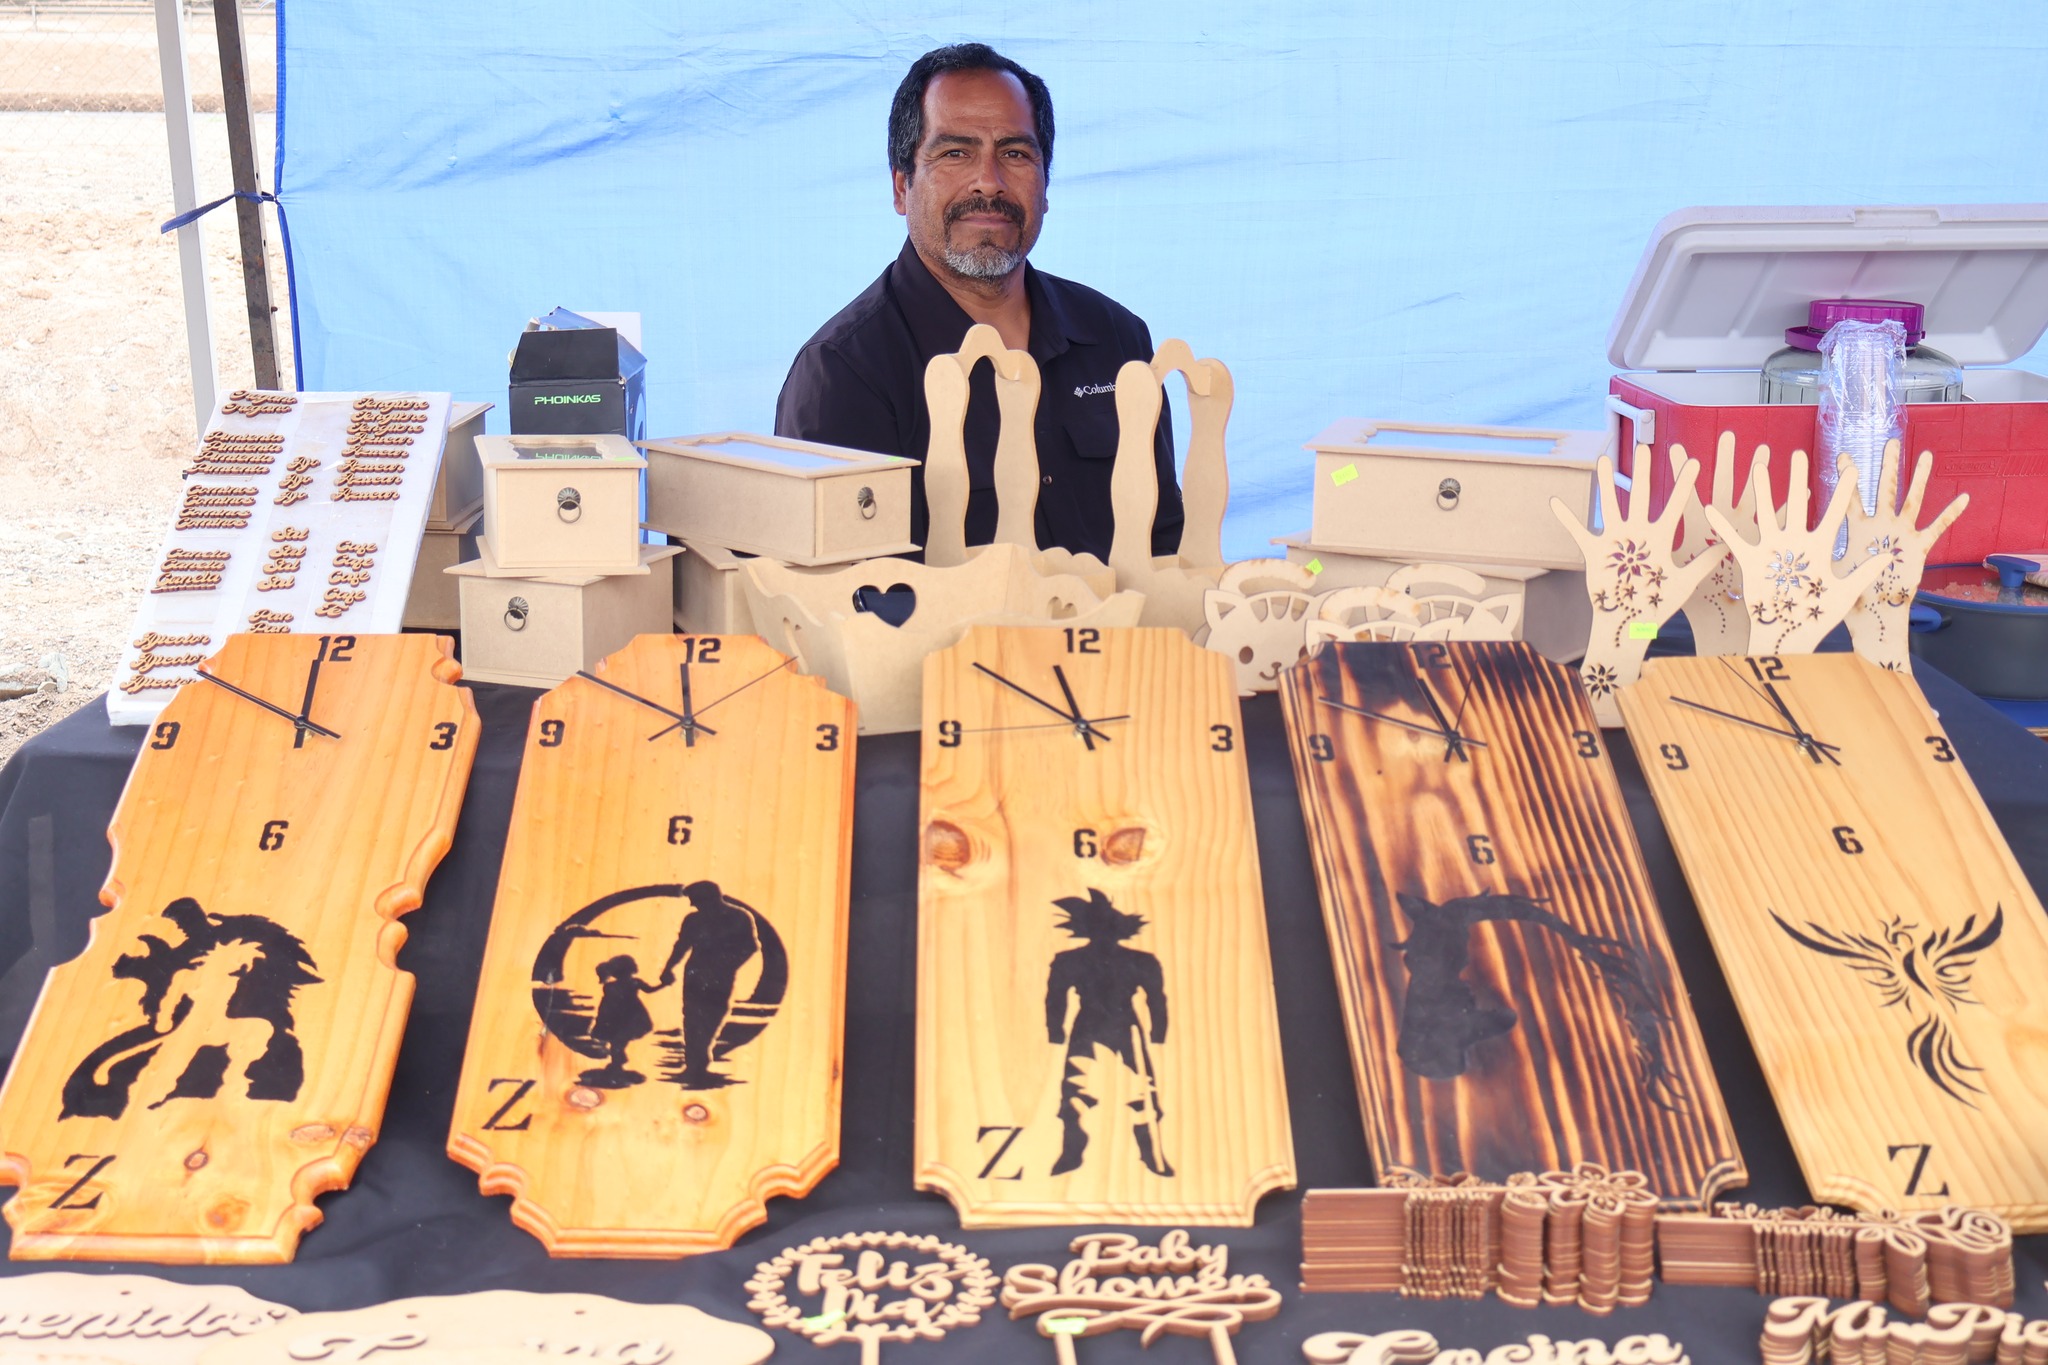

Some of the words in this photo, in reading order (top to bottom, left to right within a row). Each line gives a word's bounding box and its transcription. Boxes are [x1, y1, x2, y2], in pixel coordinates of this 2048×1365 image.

[534, 394, 602, 406] PHOINKAS
[317, 635, 357, 662] 12
[682, 637, 721, 664] 12
[1063, 628, 1101, 654] 12
[1409, 643, 1452, 669] 12
[1744, 655, 1791, 682] 12
[151, 721, 181, 750] 9
[430, 721, 458, 751] 3
[538, 719, 565, 747] 9
[815, 724, 840, 751] 3
[939, 719, 962, 748] 9
[1210, 724, 1234, 752] 3
[1308, 733, 1336, 762] 9
[1572, 730, 1600, 759] 3
[1659, 743, 1690, 771] 9
[1925, 735, 1956, 763] 3
[258, 819, 289, 851] 6
[666, 815, 694, 845] 6
[1073, 828, 1098, 858] 6
[1831, 825, 1864, 855] 6
[1466, 834, 1496, 865] 6
[481, 1078, 537, 1131] Z
[976, 1125, 1024, 1180] Z
[48, 1153, 118, 1210] Z
[1887, 1142, 1949, 1197] Z
[1069, 1229, 1229, 1281] Baby
[797, 1249, 955, 1301] Feliz
[1001, 1258, 1272, 1306] Shower
